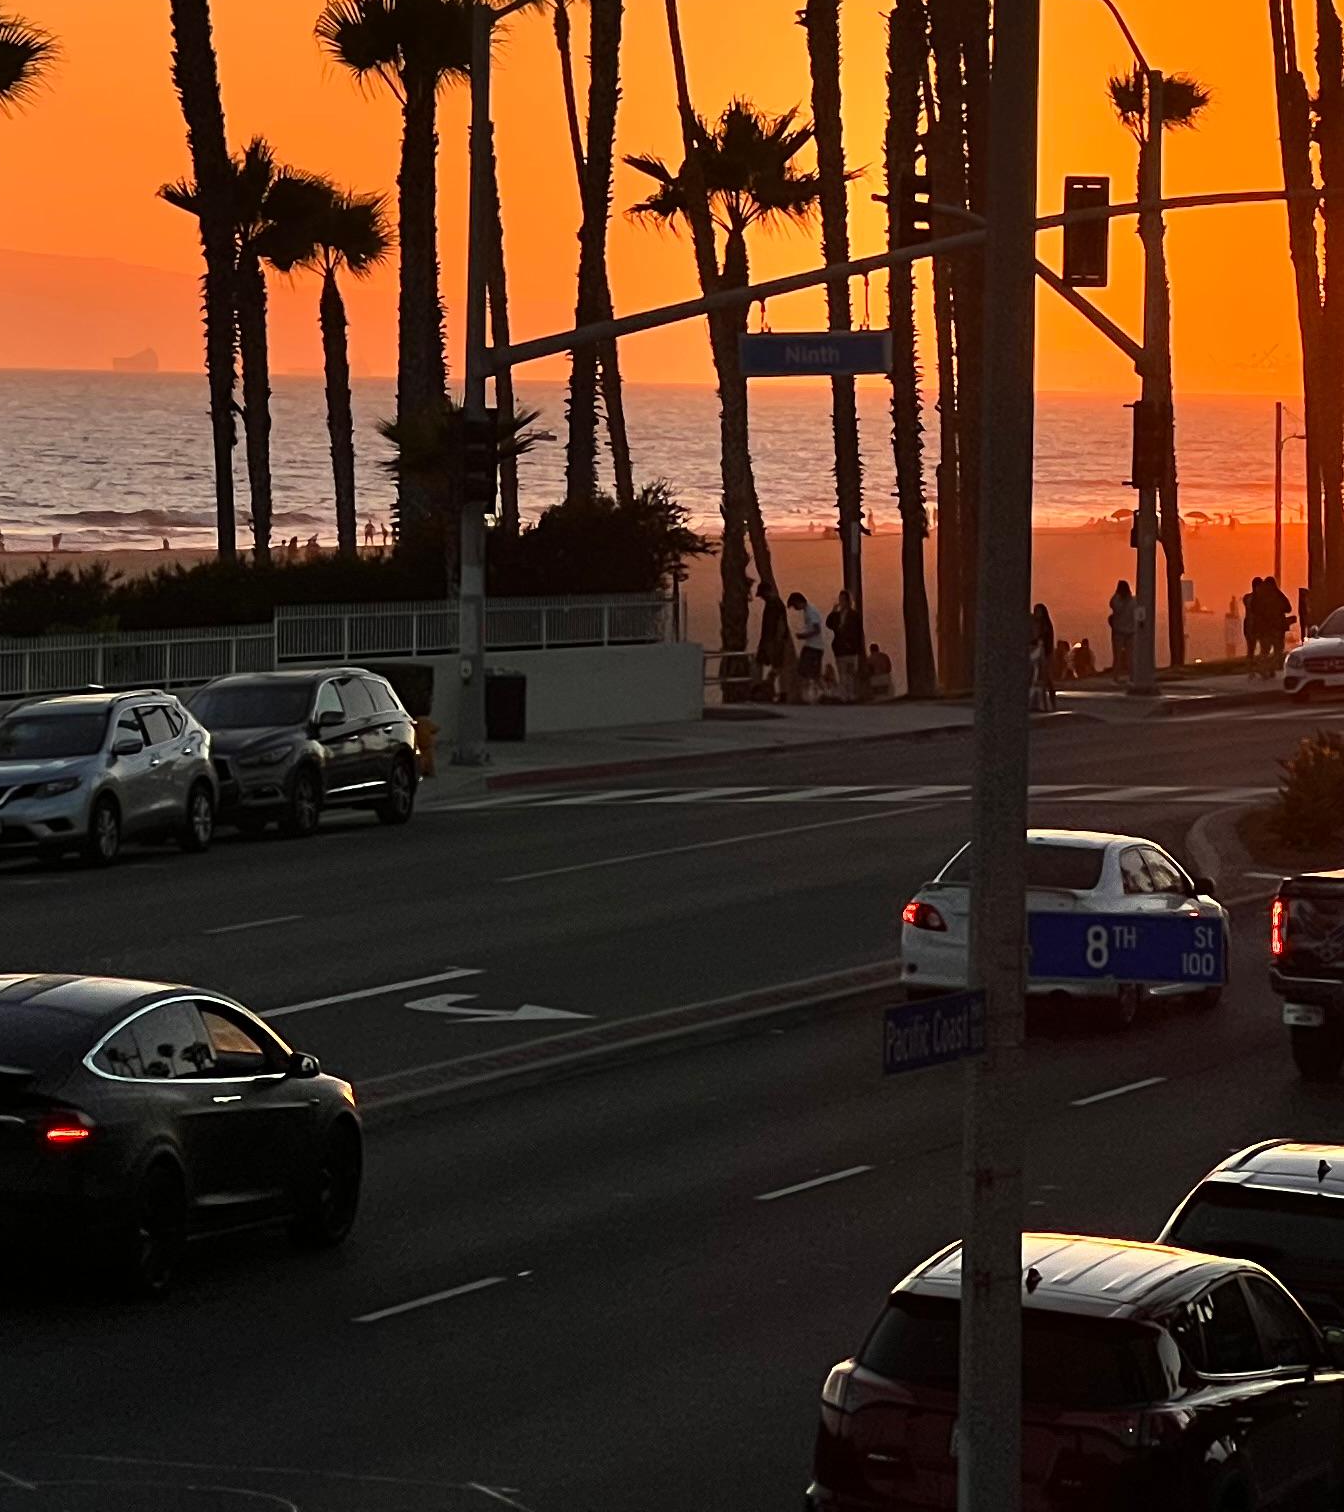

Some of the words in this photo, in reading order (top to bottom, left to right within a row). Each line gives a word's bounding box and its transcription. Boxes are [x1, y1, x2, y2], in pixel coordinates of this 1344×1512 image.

[785, 345, 840, 364] Ninth
[1086, 925, 1136, 968] 8TH
[1196, 926, 1215, 949] St
[1184, 953, 1215, 976] 100
